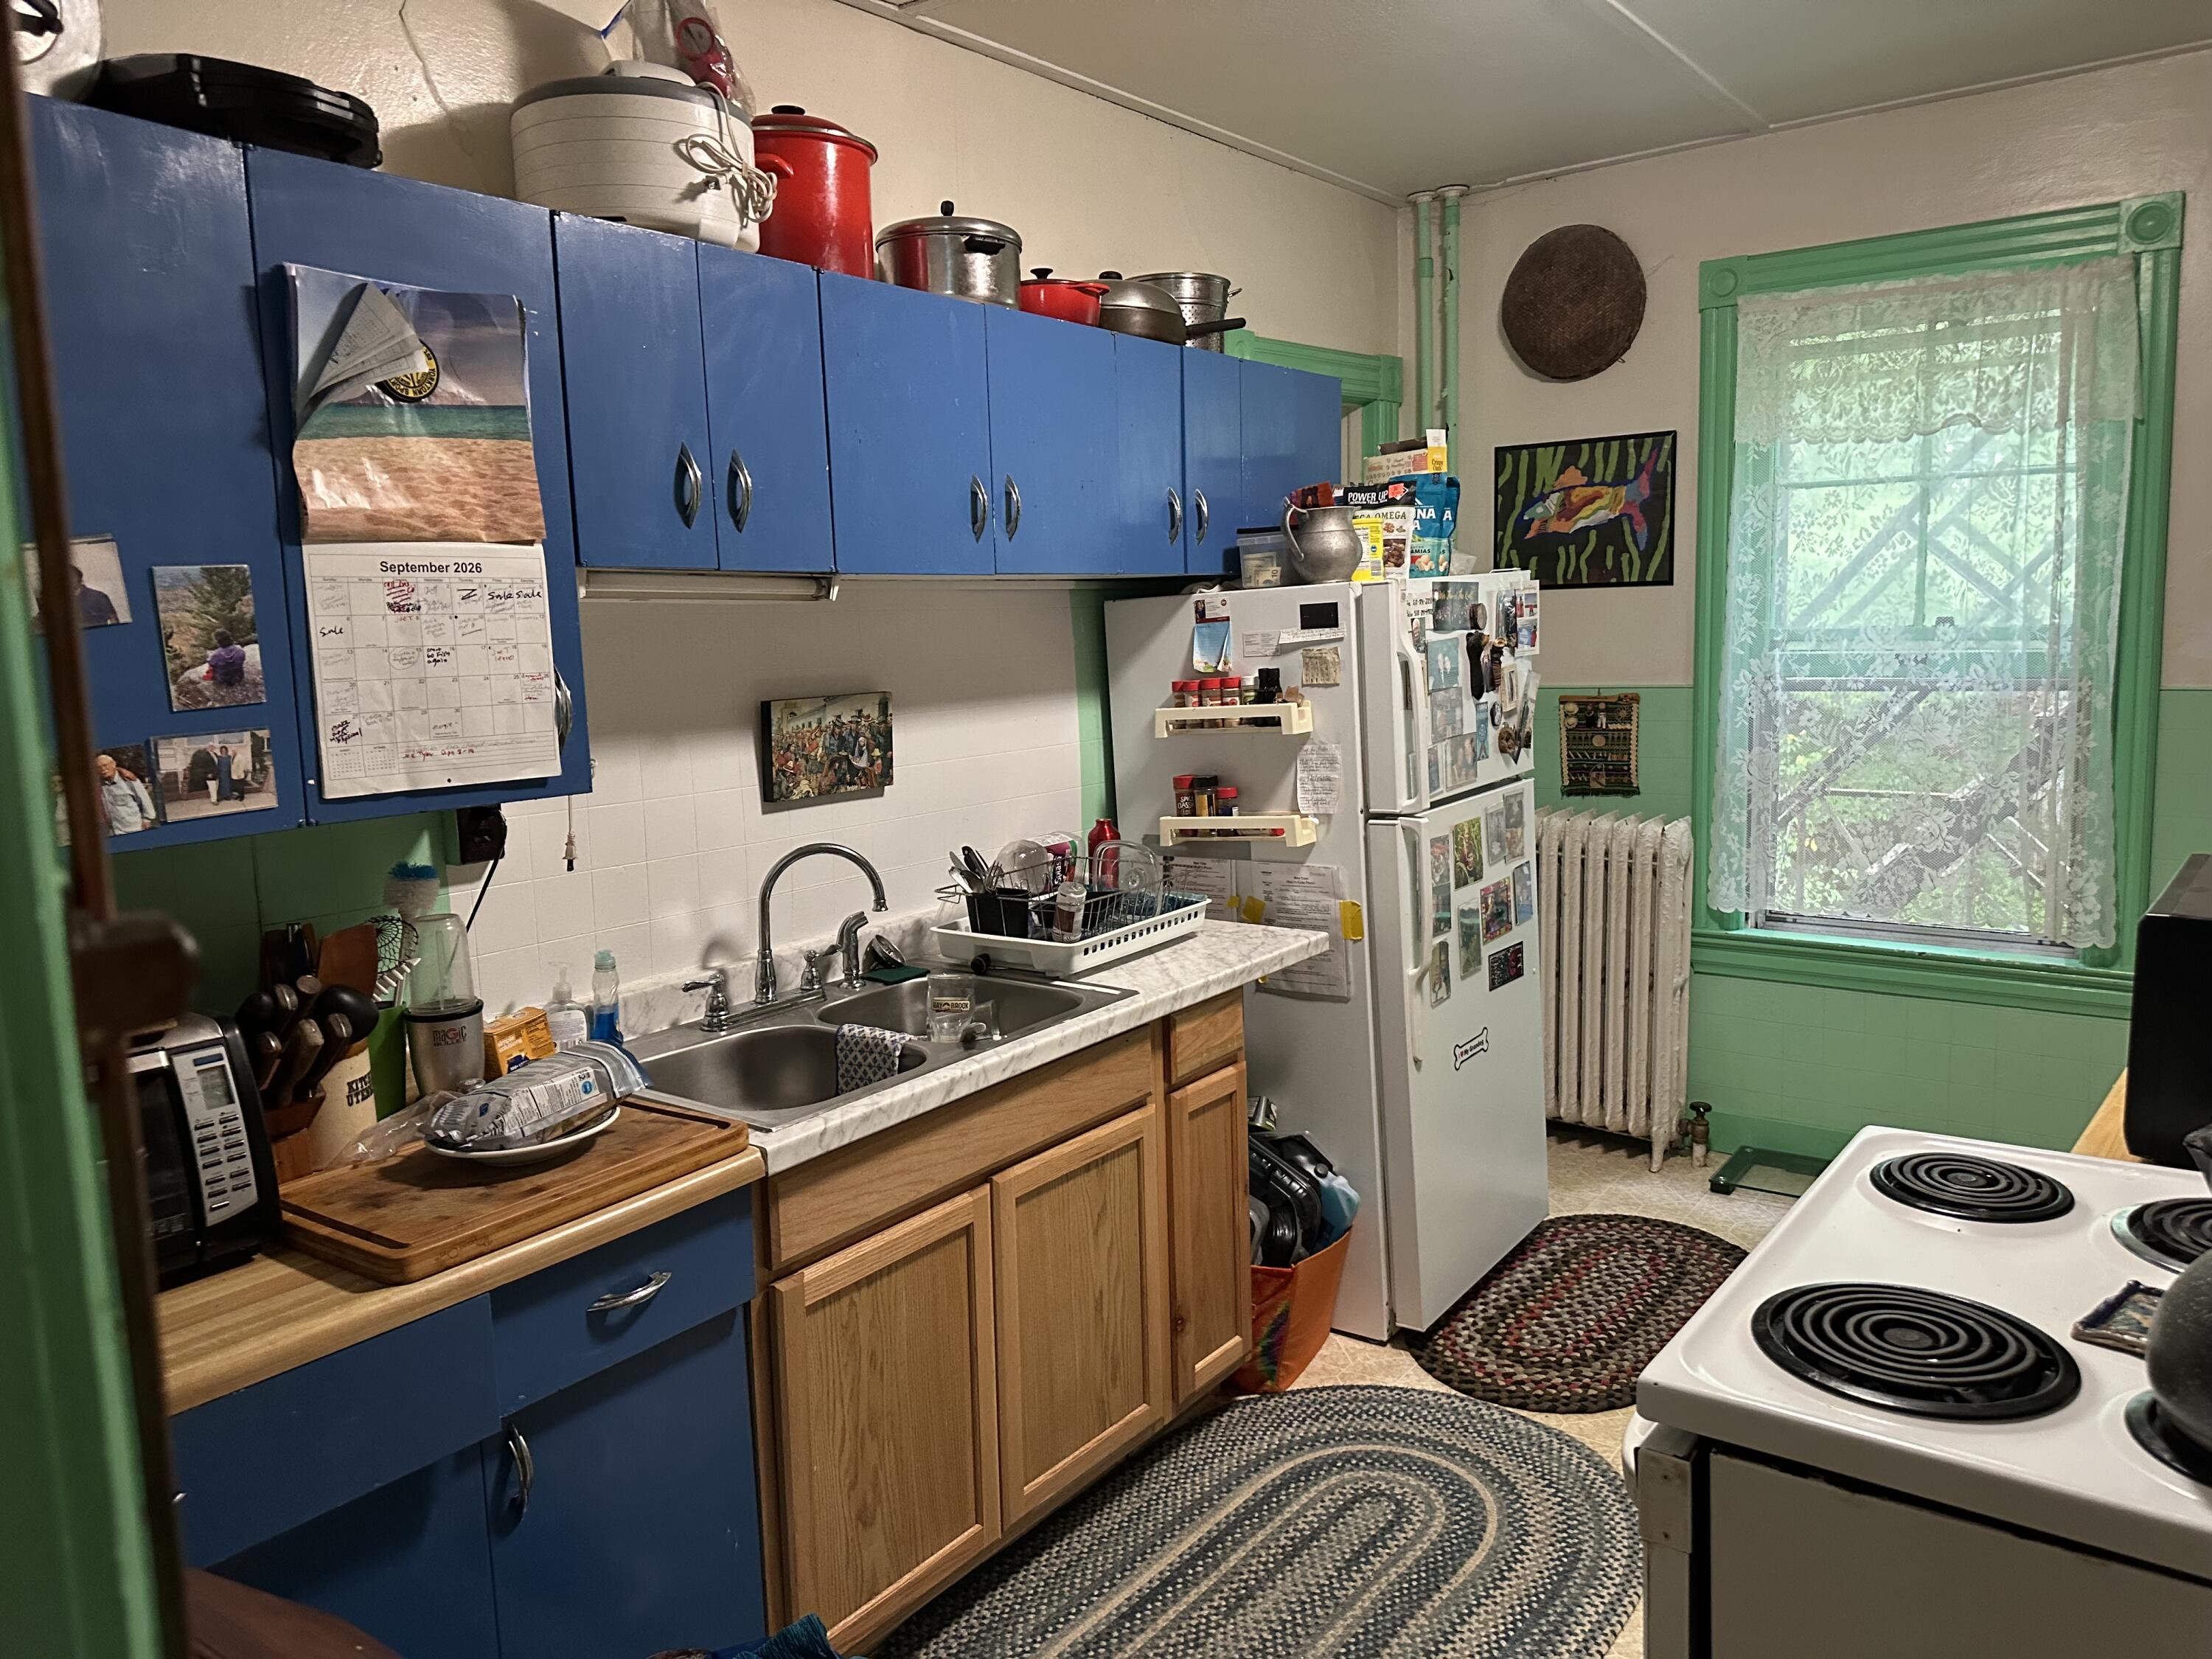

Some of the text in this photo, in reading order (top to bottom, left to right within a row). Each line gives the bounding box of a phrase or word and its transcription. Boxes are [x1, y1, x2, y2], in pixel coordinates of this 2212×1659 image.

[1348, 490, 1388, 502] POWER UP
[1374, 511, 1407, 520] OMEGA
[380, 560, 482, 575] September 2026
[1271, 569, 1279, 579] 10
[346, 1085, 375, 1107] UTEN
